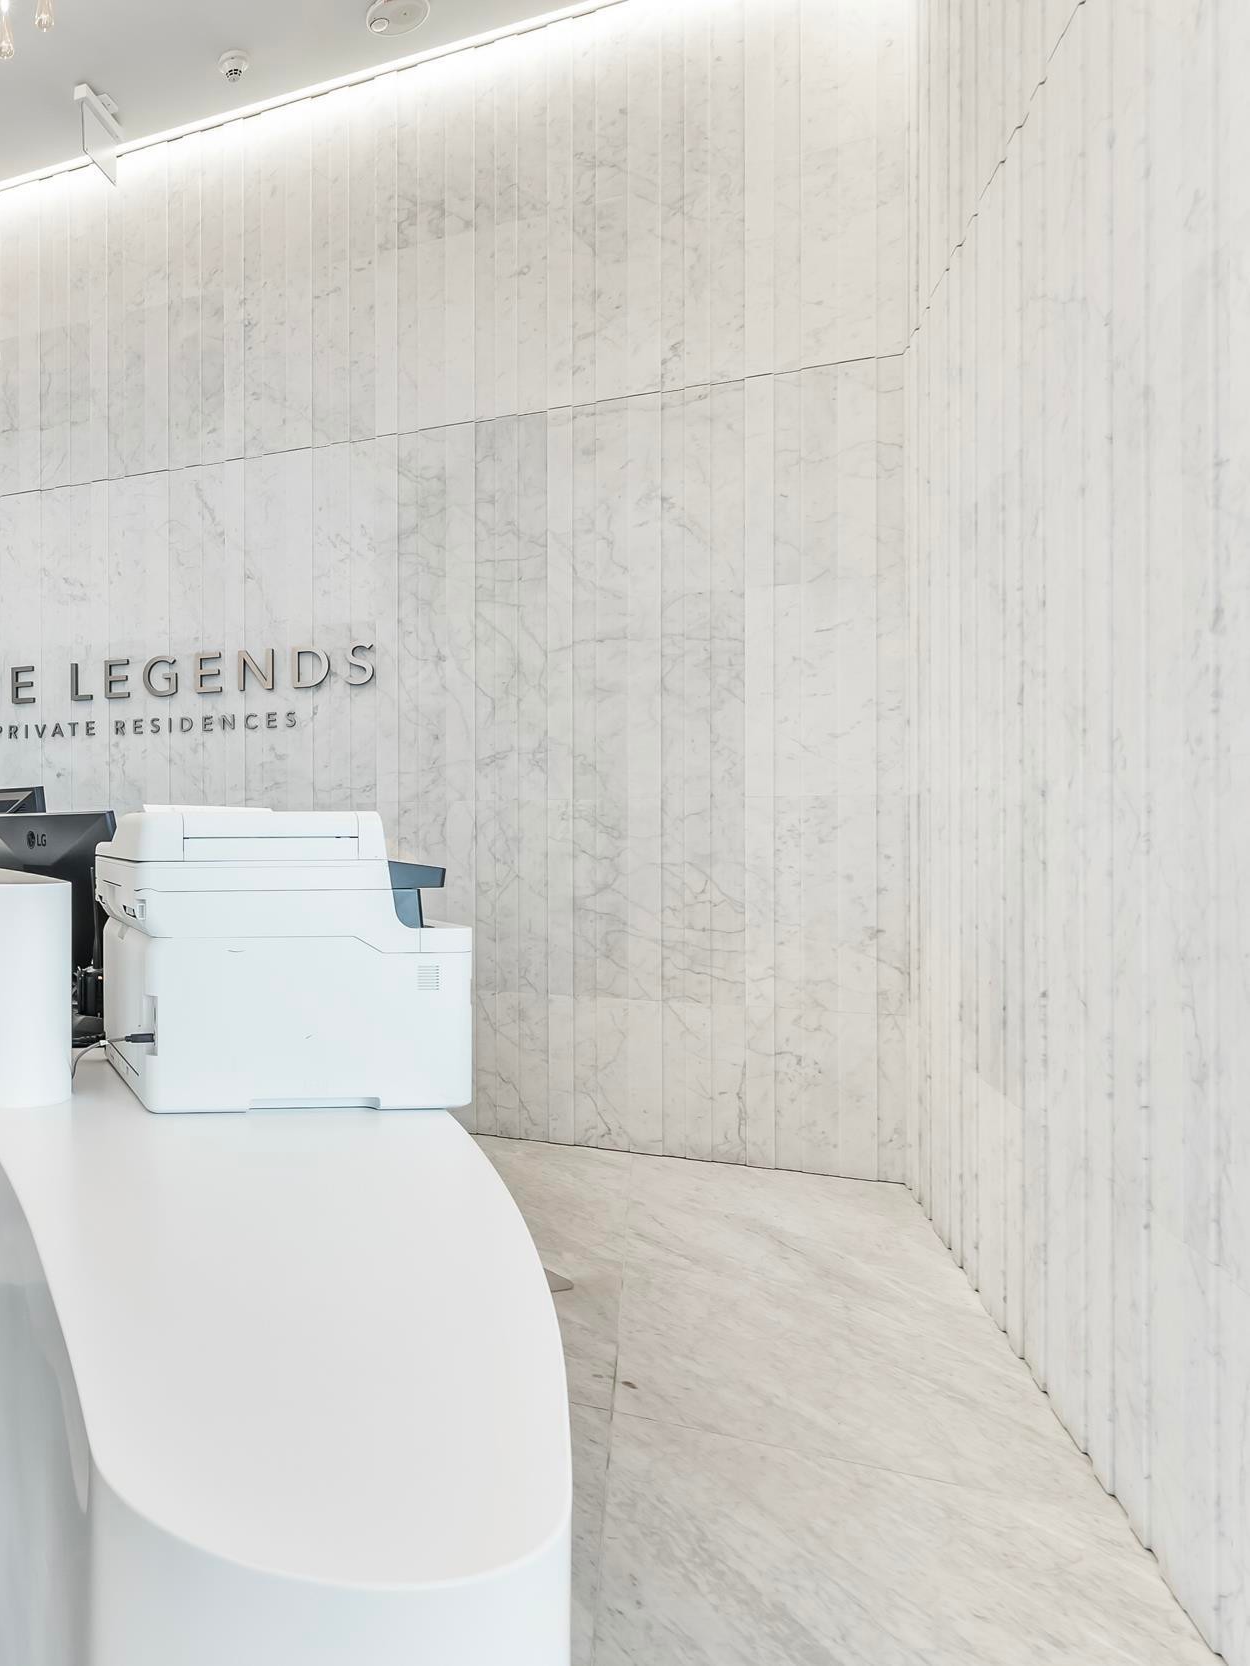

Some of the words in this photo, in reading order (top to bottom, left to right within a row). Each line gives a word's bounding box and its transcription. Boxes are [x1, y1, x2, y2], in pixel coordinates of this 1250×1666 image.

[70, 642, 376, 702] LEGENDS
[115, 711, 298, 736] RESIDENCES
[36, 833, 47, 847] LG
